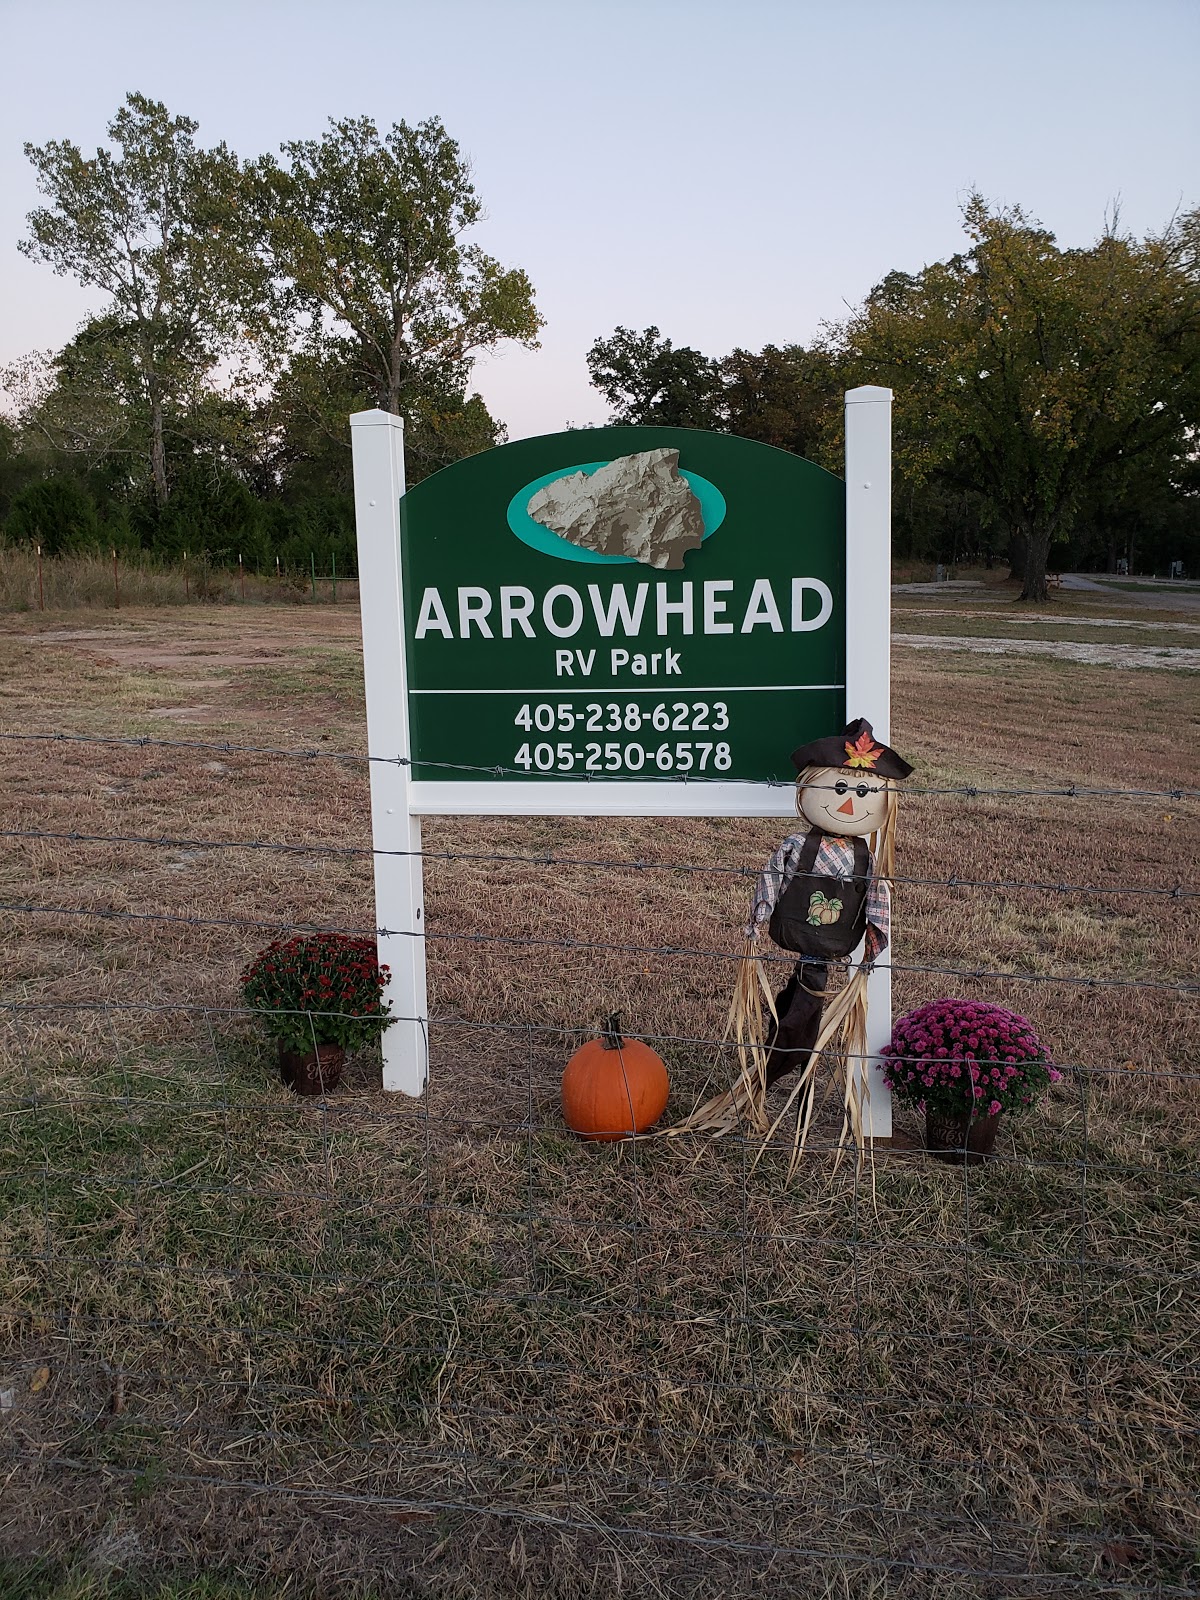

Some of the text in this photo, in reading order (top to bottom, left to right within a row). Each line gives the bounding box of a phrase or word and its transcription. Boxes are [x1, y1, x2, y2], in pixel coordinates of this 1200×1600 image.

[414, 577, 834, 640] ARROWHEAD
[554, 647, 682, 677] RV Park
[514, 701, 731, 733] 405-238-6223
[514, 742, 733, 771] 405-250-6578
